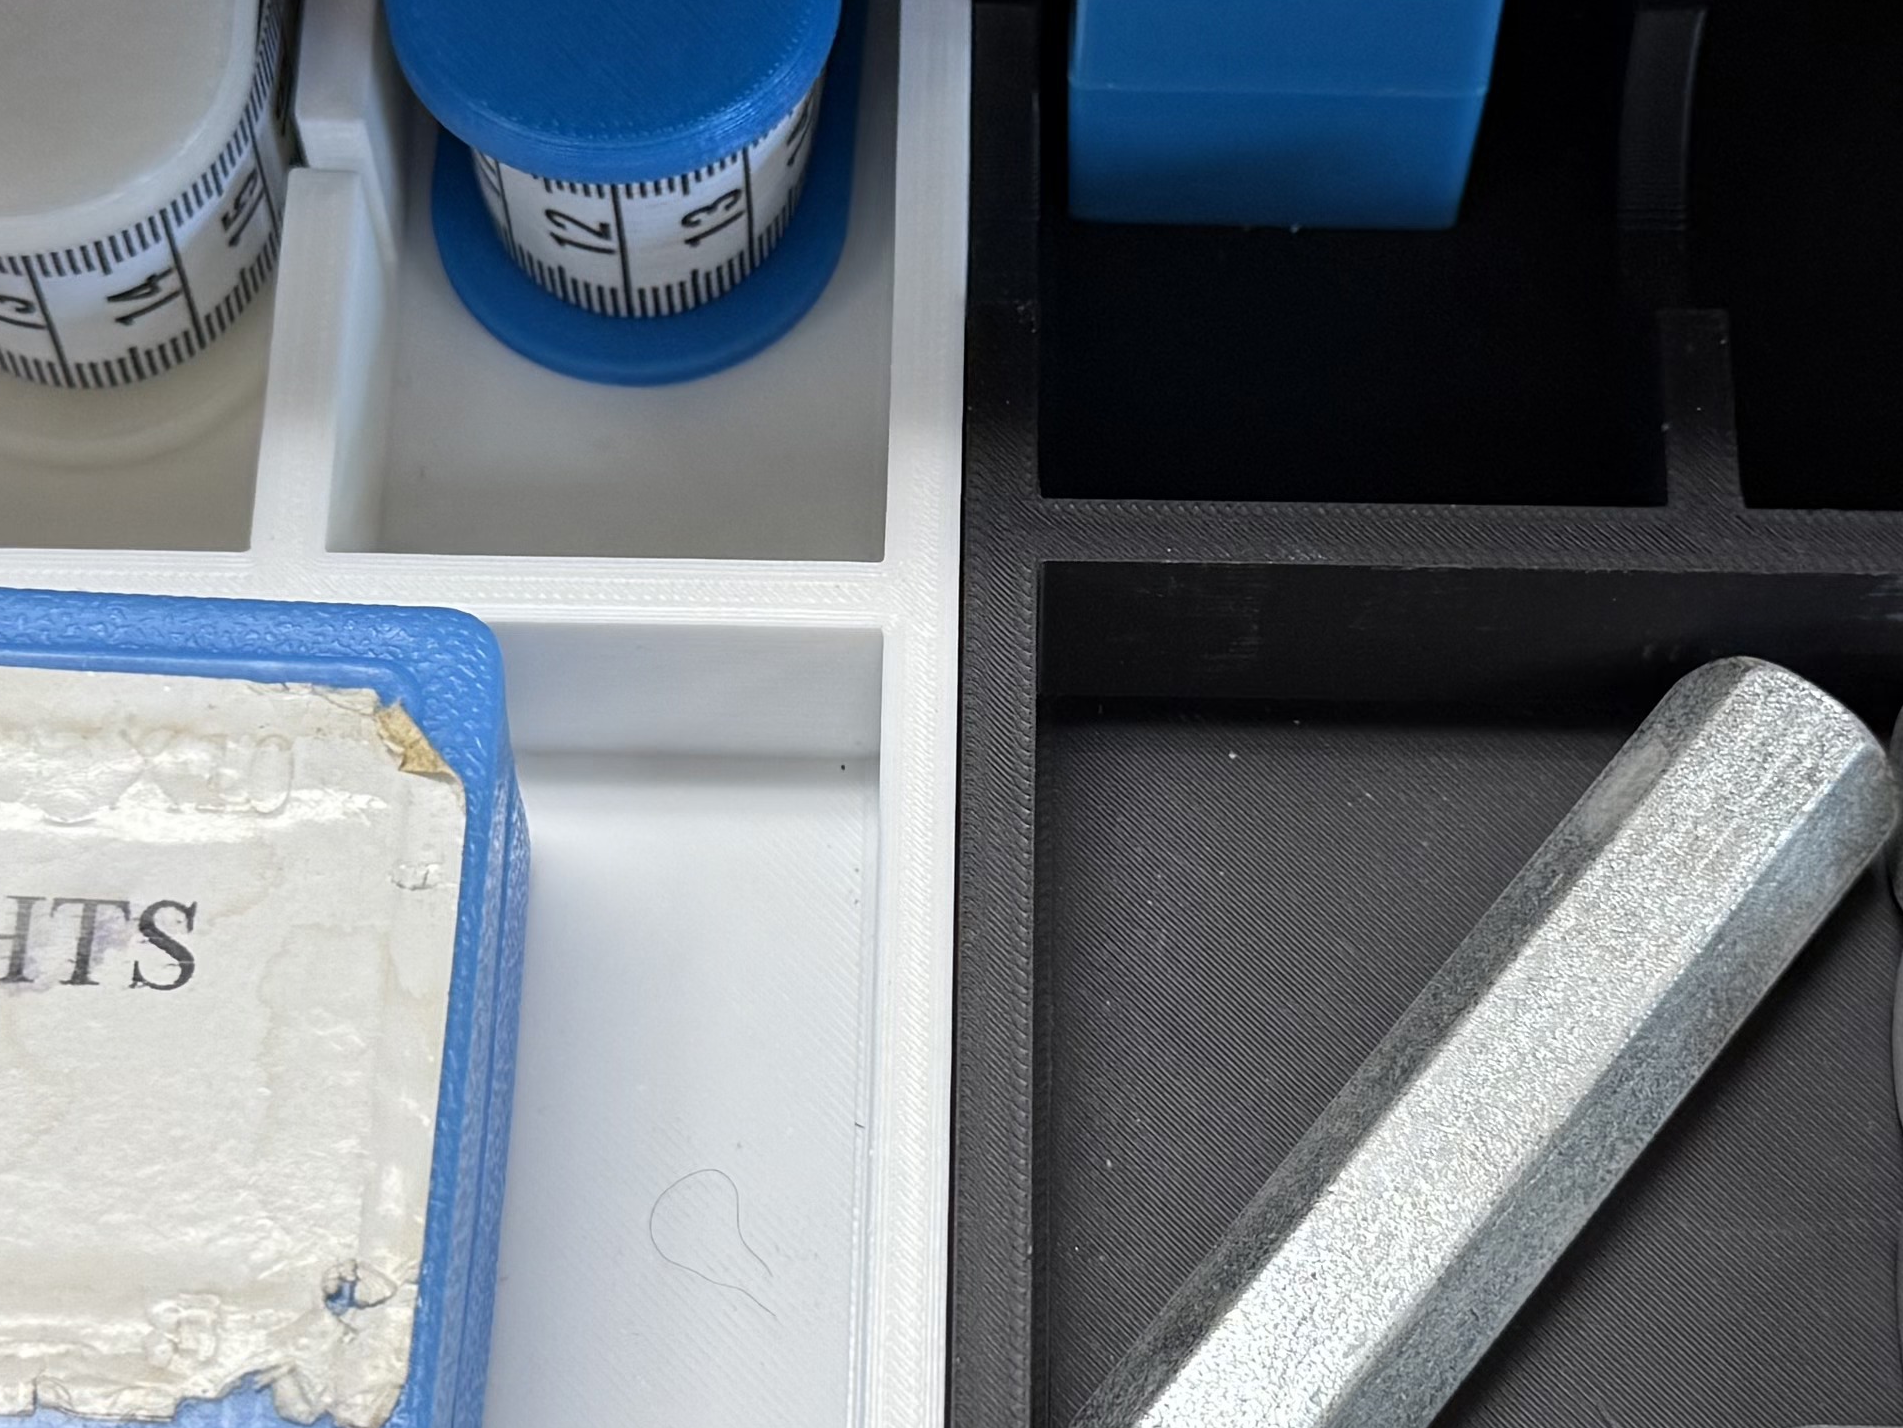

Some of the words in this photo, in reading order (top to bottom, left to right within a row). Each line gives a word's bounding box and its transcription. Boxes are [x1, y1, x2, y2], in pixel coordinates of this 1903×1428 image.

[221, 168, 266, 248] 15
[544, 207, 618, 255] 12
[680, 188, 747, 247] 13
[106, 267, 184, 325] 14
